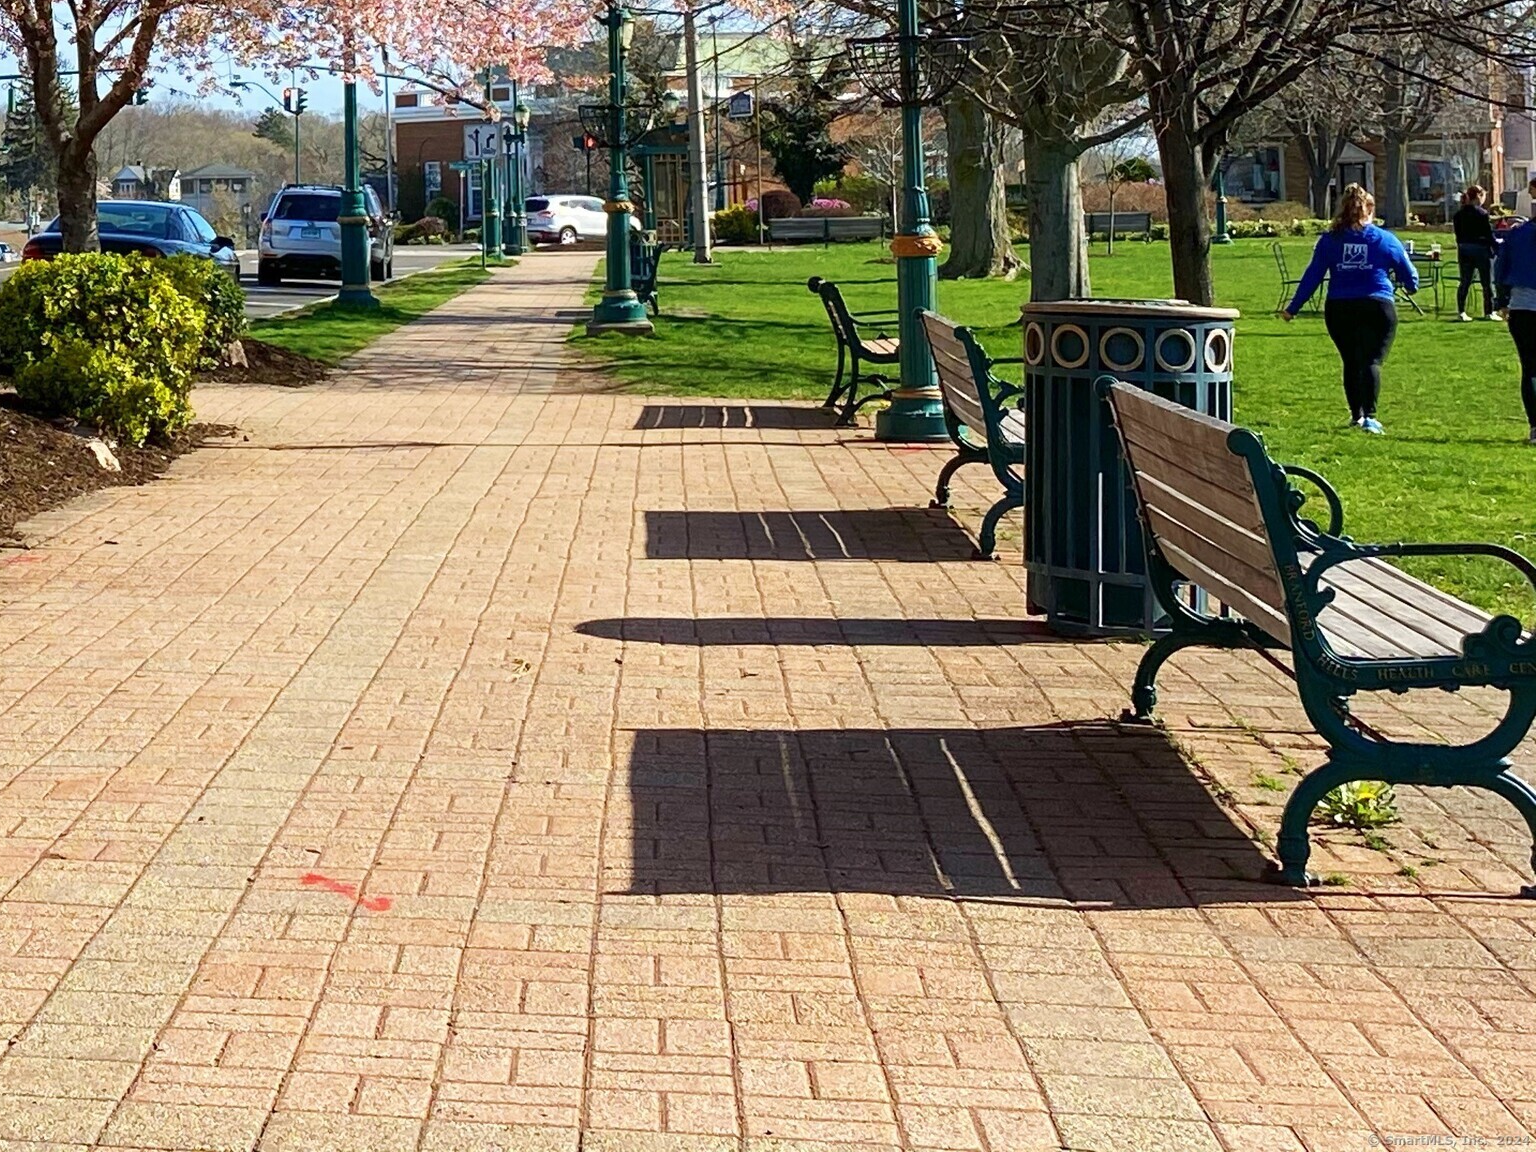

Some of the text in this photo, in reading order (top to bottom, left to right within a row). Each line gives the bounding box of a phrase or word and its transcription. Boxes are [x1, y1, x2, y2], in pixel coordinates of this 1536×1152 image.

[1284, 564, 1316, 641] BRANFORD
[1377, 665, 1435, 681] HEALTH
[1451, 663, 1490, 679] CARE
